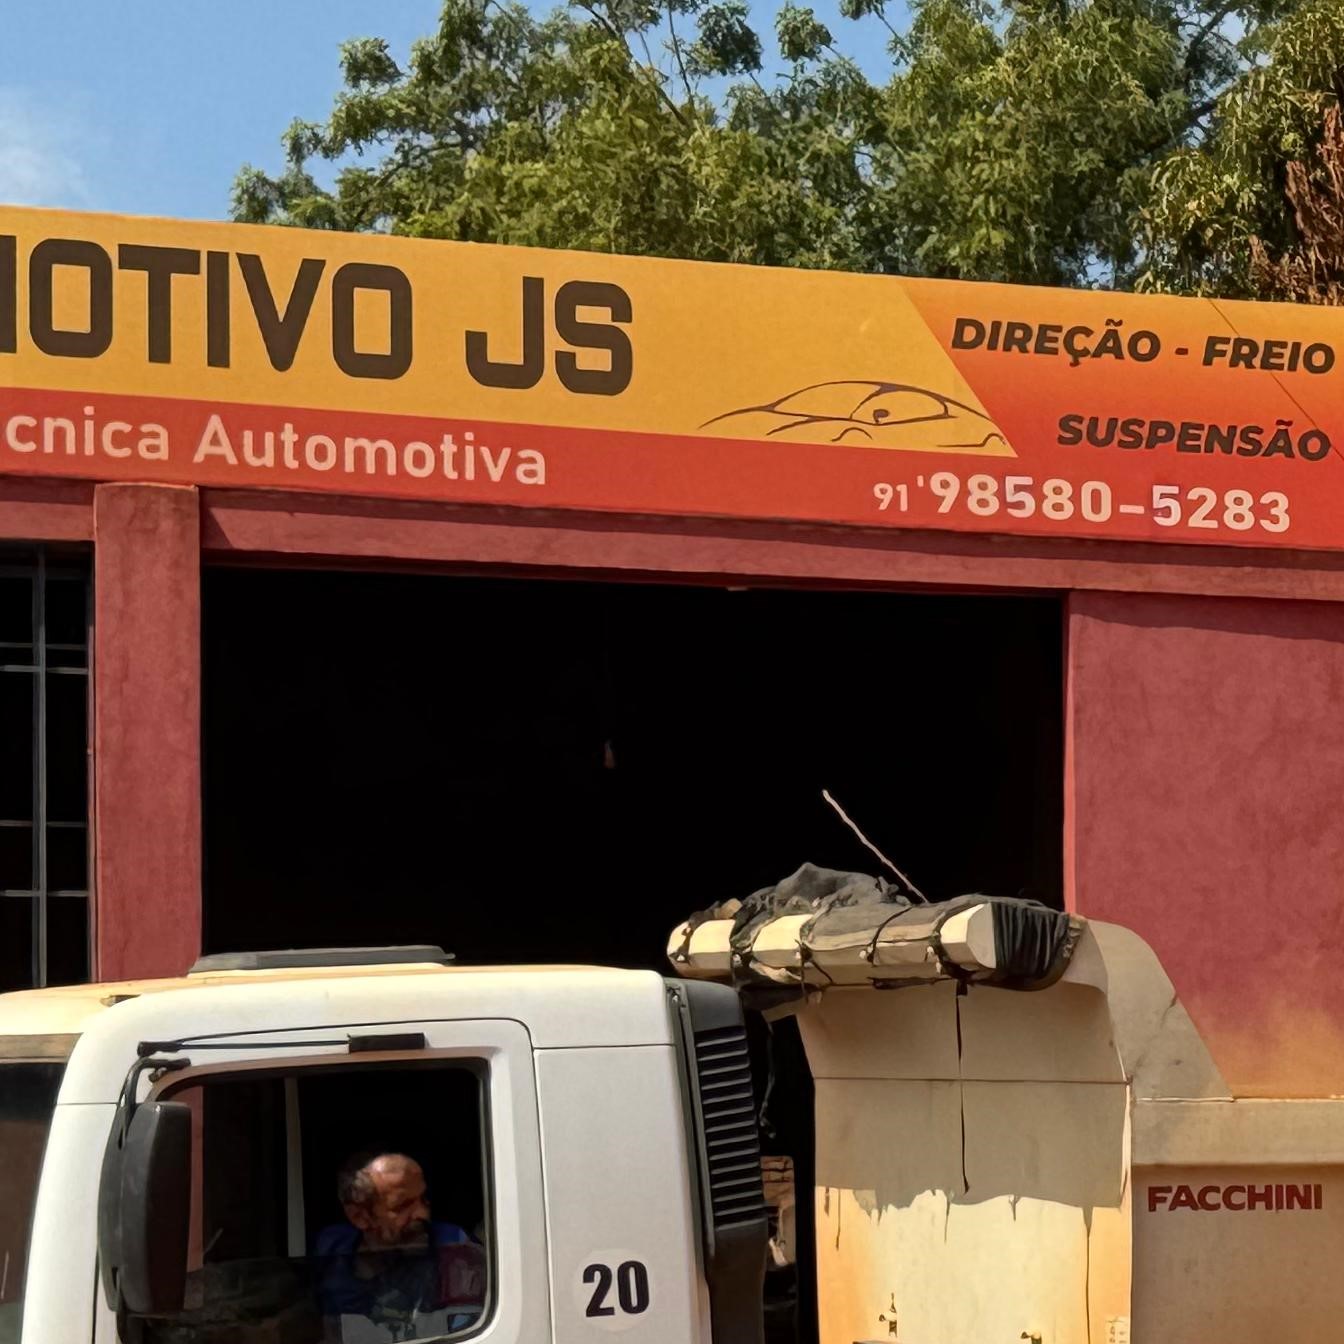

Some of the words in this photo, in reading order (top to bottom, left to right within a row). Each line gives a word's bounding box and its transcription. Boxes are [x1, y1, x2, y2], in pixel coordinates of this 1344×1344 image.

[465, 276, 634, 397] JS
[951, 317, 1162, 367] DIREÇÃO
[1202, 335, 1336, 375] FREIO
[193, 414, 547, 486] Automotiva
[1057, 414, 1332, 462] SUSPENSÃO
[873, 482, 908, 512] 91
[1147, 1184, 1323, 1212] FACCHINI
[583, 1260, 650, 1318] 20
